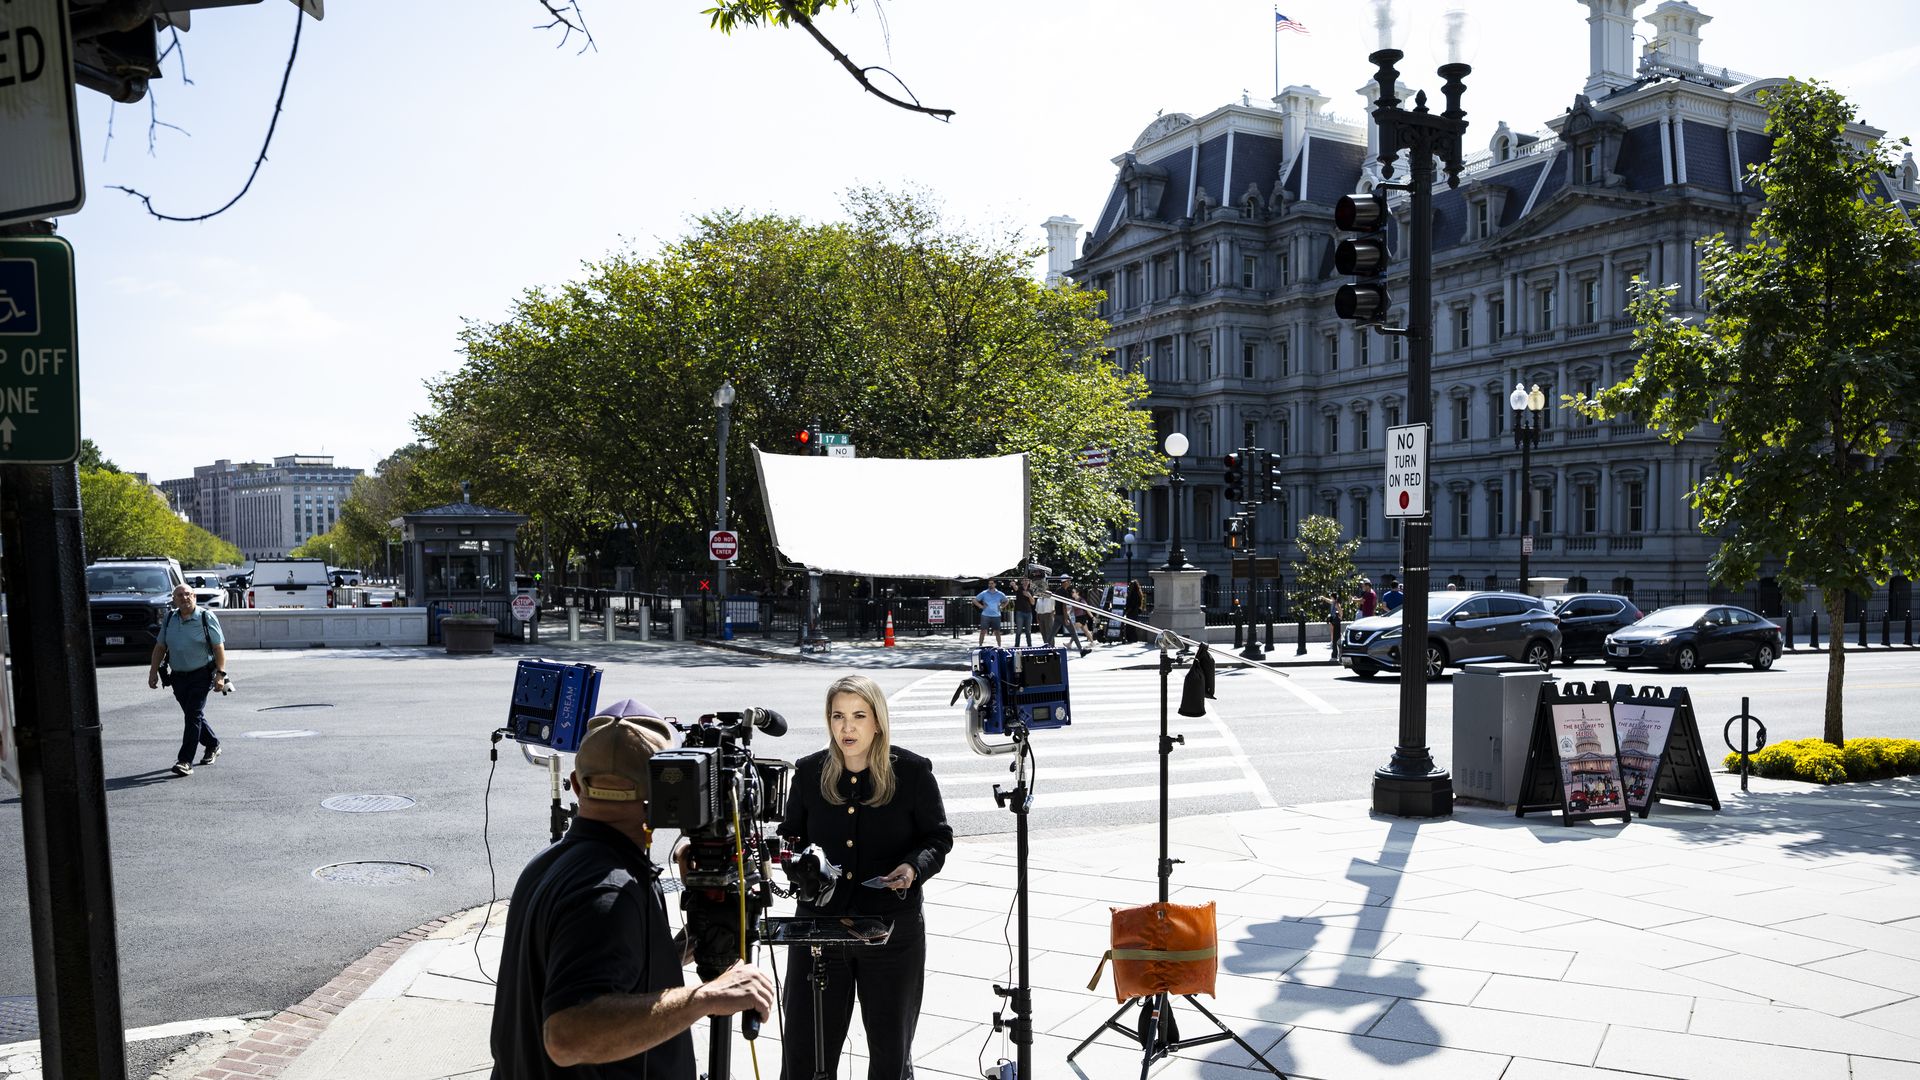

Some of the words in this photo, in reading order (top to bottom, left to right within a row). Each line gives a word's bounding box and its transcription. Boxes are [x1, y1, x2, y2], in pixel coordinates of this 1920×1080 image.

[21, 347, 67, 376] OFF
[825, 435, 835, 443] 17
[1397, 432, 1414, 450] NO
[1394, 454, 1417, 469] TURN
[1389, 473, 1401, 487] ON
[1404, 472, 1421, 487] RED
[516, 598, 530, 606] STOP
